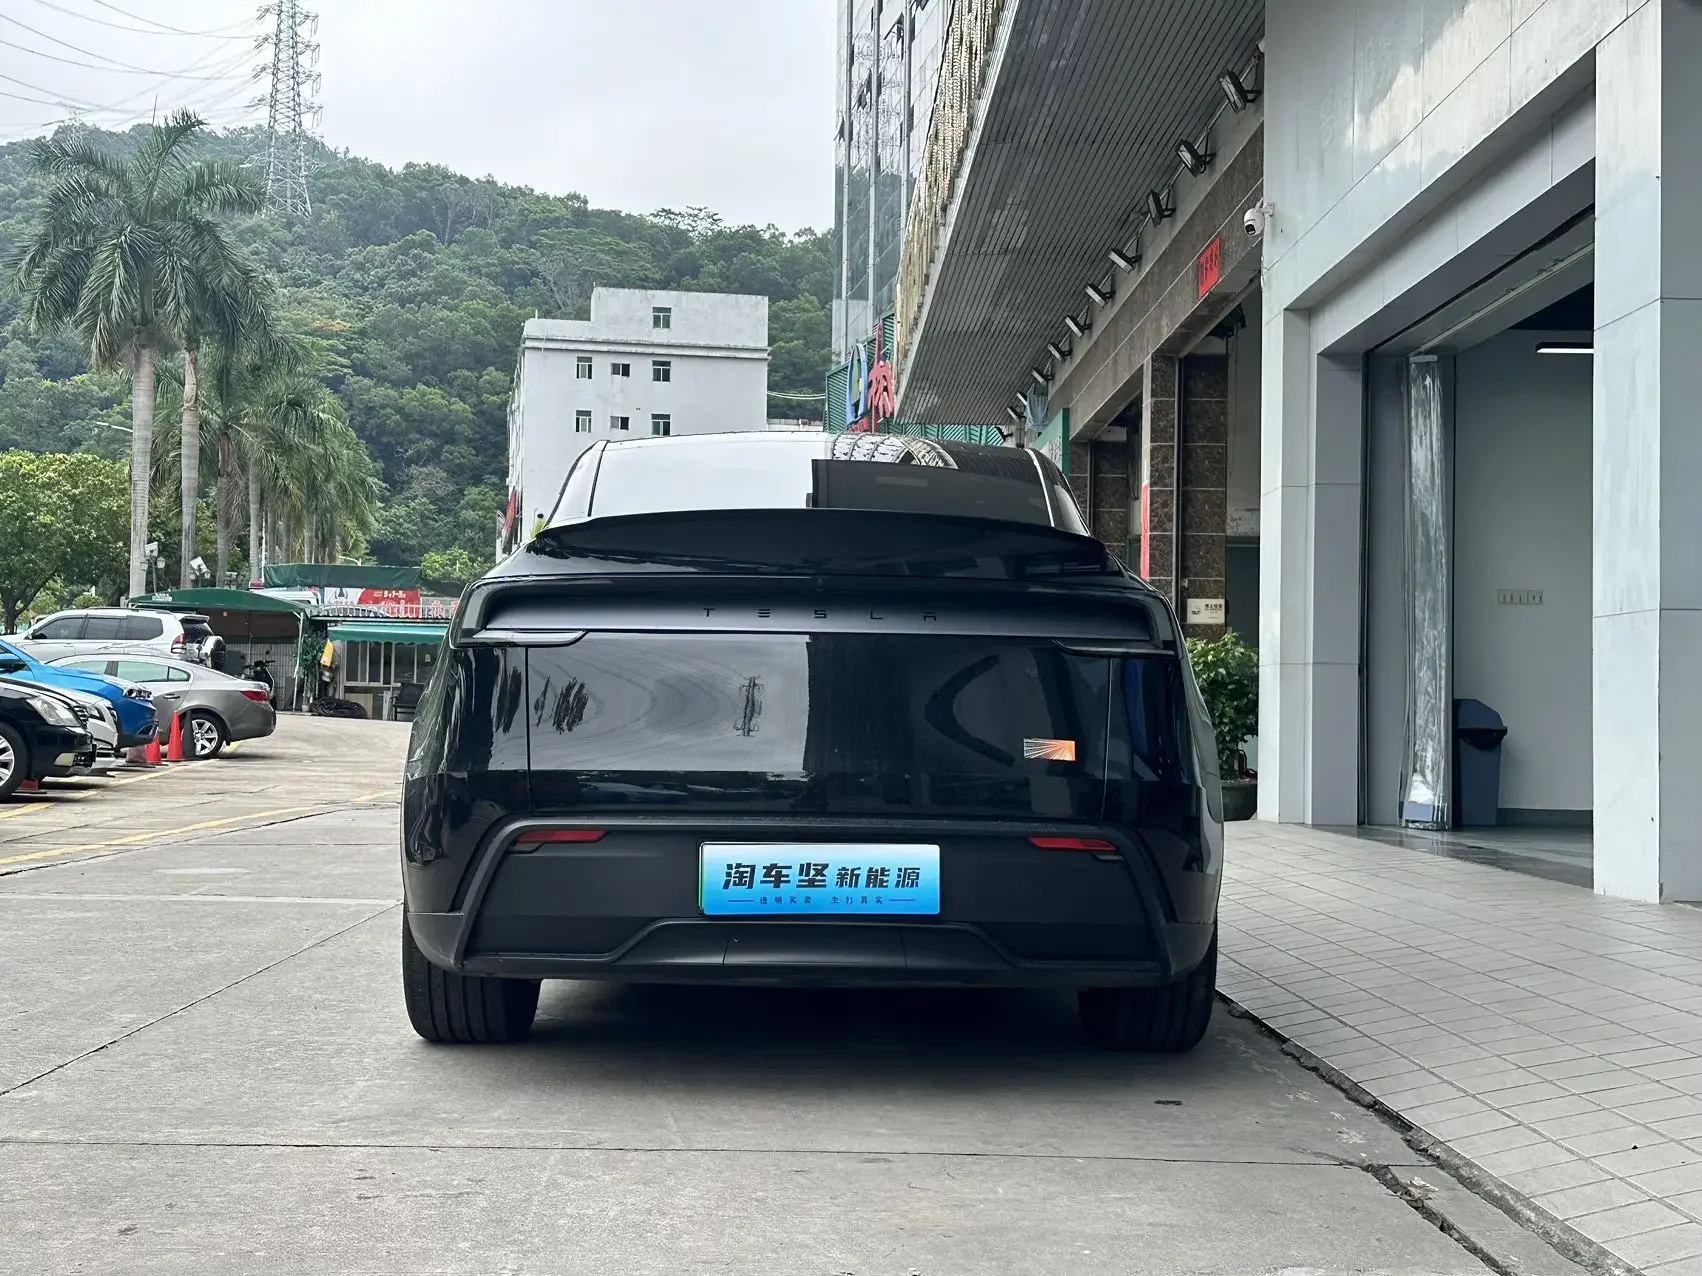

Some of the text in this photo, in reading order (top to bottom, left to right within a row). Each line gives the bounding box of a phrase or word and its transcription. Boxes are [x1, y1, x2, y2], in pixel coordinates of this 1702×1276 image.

[703, 607, 937, 622] TESLA
[722, 862, 921, 890] 淘车坚新能源
[759, 896, 884, 905] 透明买卖 主打真实
